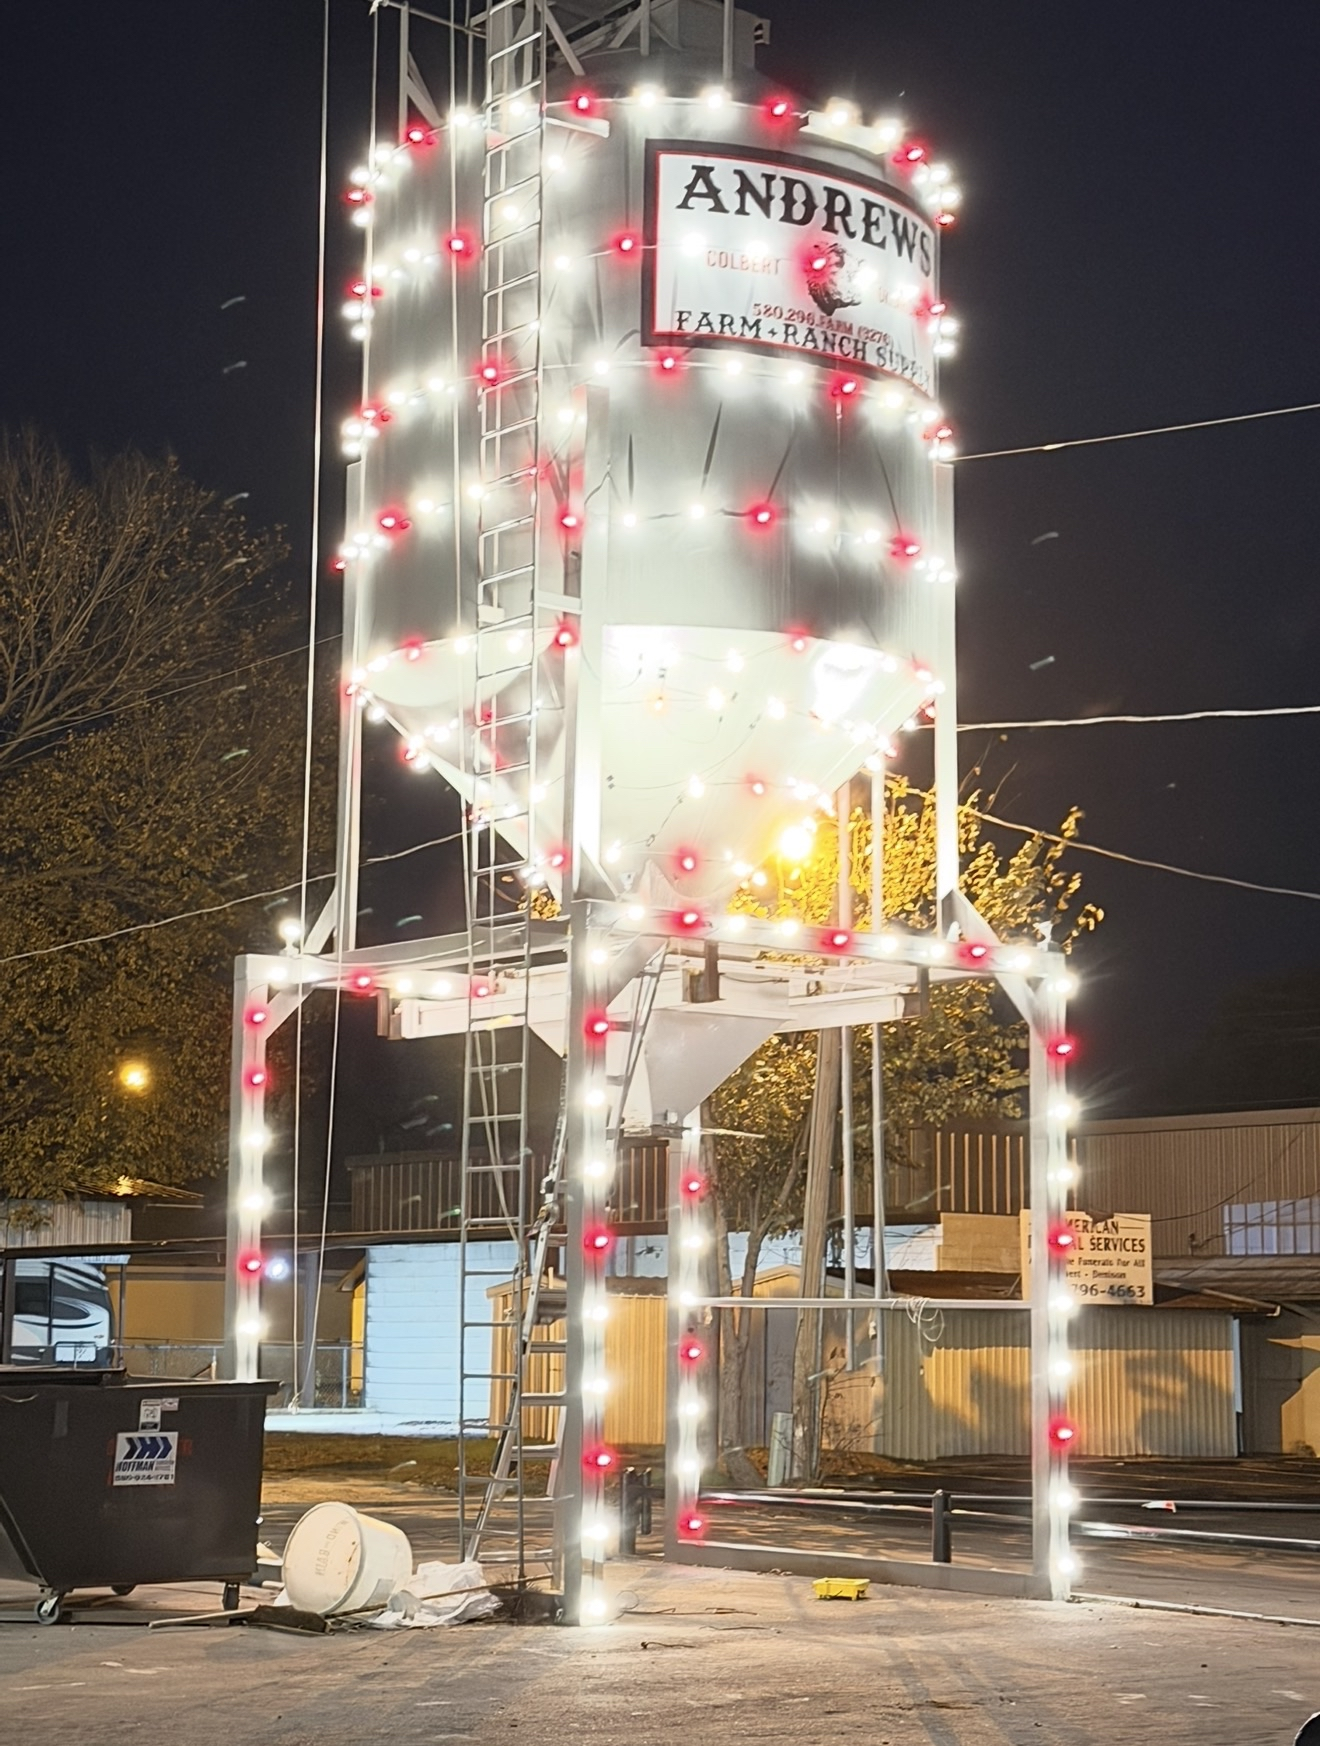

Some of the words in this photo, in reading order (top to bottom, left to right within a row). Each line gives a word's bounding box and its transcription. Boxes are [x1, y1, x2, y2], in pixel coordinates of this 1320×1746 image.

[675, 165, 931, 278] ANDREWS
[707, 250, 780, 275] COLBERT
[1090, 1235, 1146, 1253] SERVICES
